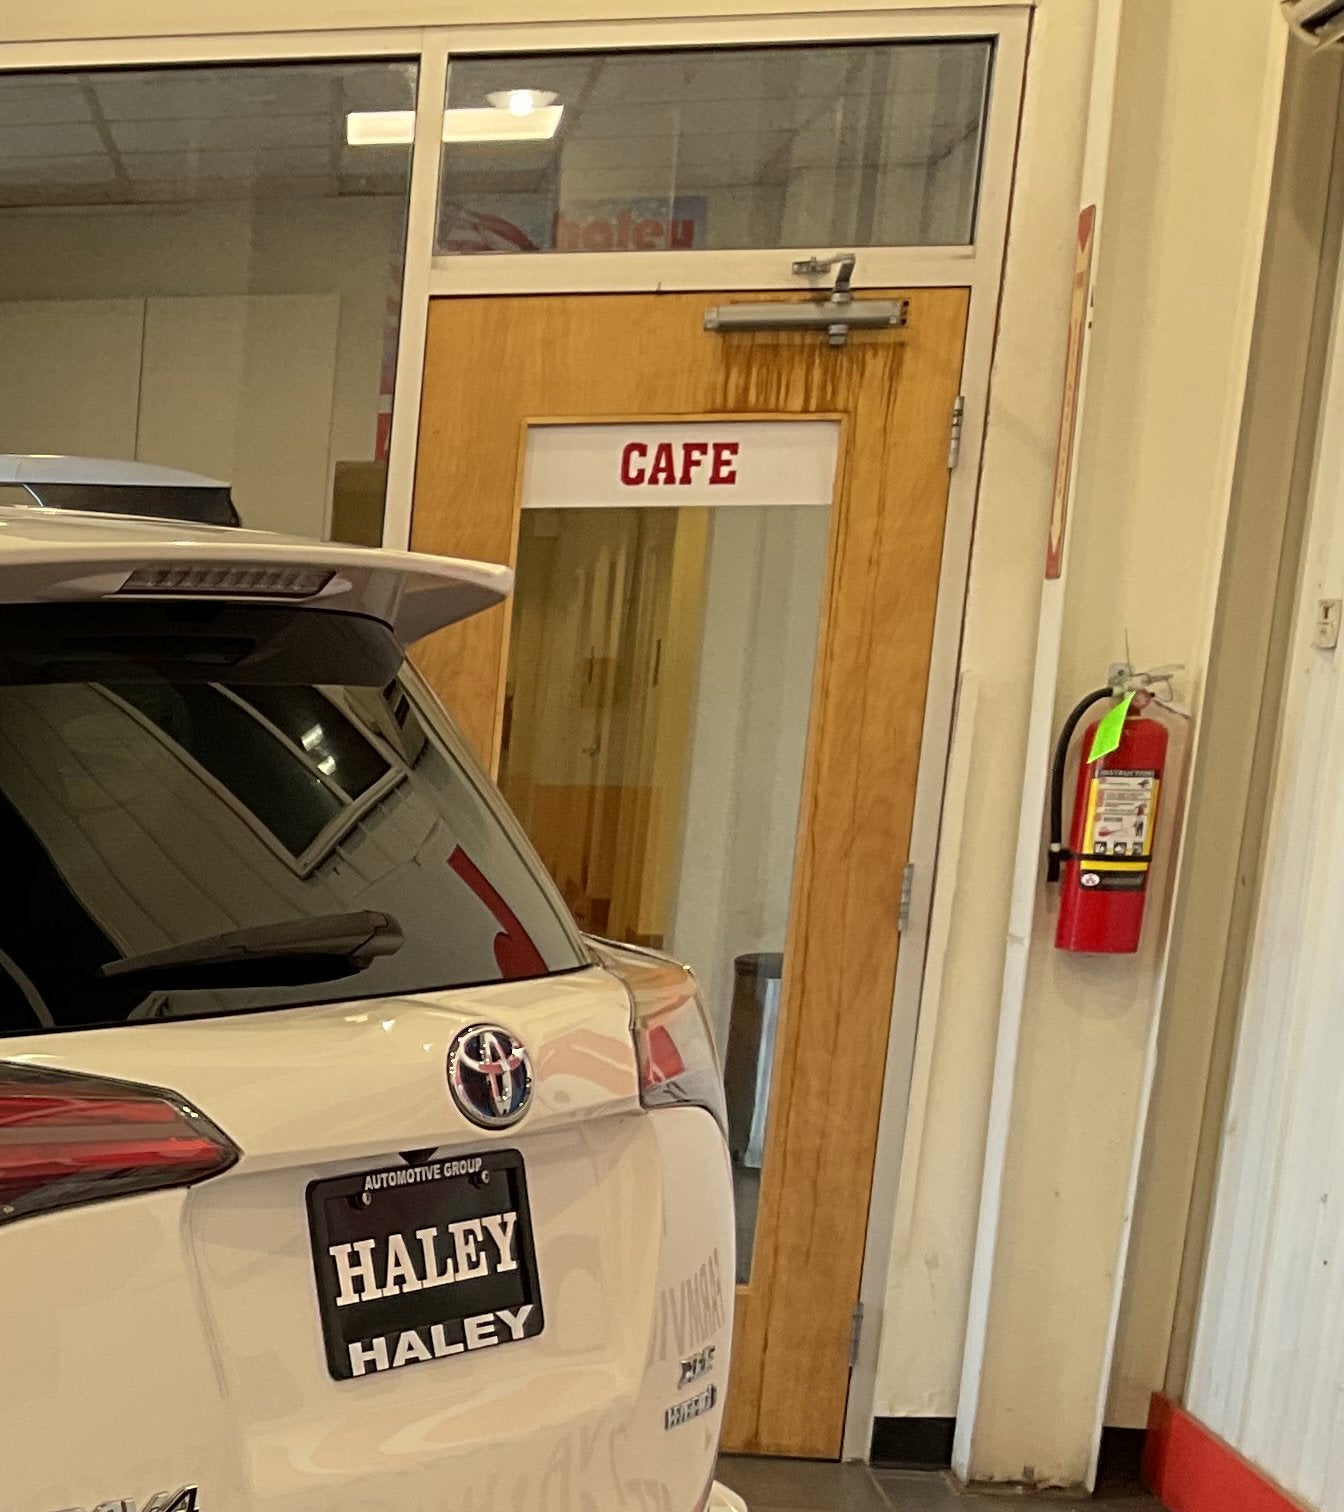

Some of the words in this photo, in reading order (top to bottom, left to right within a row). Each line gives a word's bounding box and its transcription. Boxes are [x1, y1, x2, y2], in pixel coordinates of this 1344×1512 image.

[620, 442, 739, 486] CAFE
[364, 1163, 441, 1190] AUTOMOTIVE
[444, 1158, 483, 1177] GROUP
[329, 1211, 518, 1307] HALEY
[348, 1304, 534, 1377] HALEY
